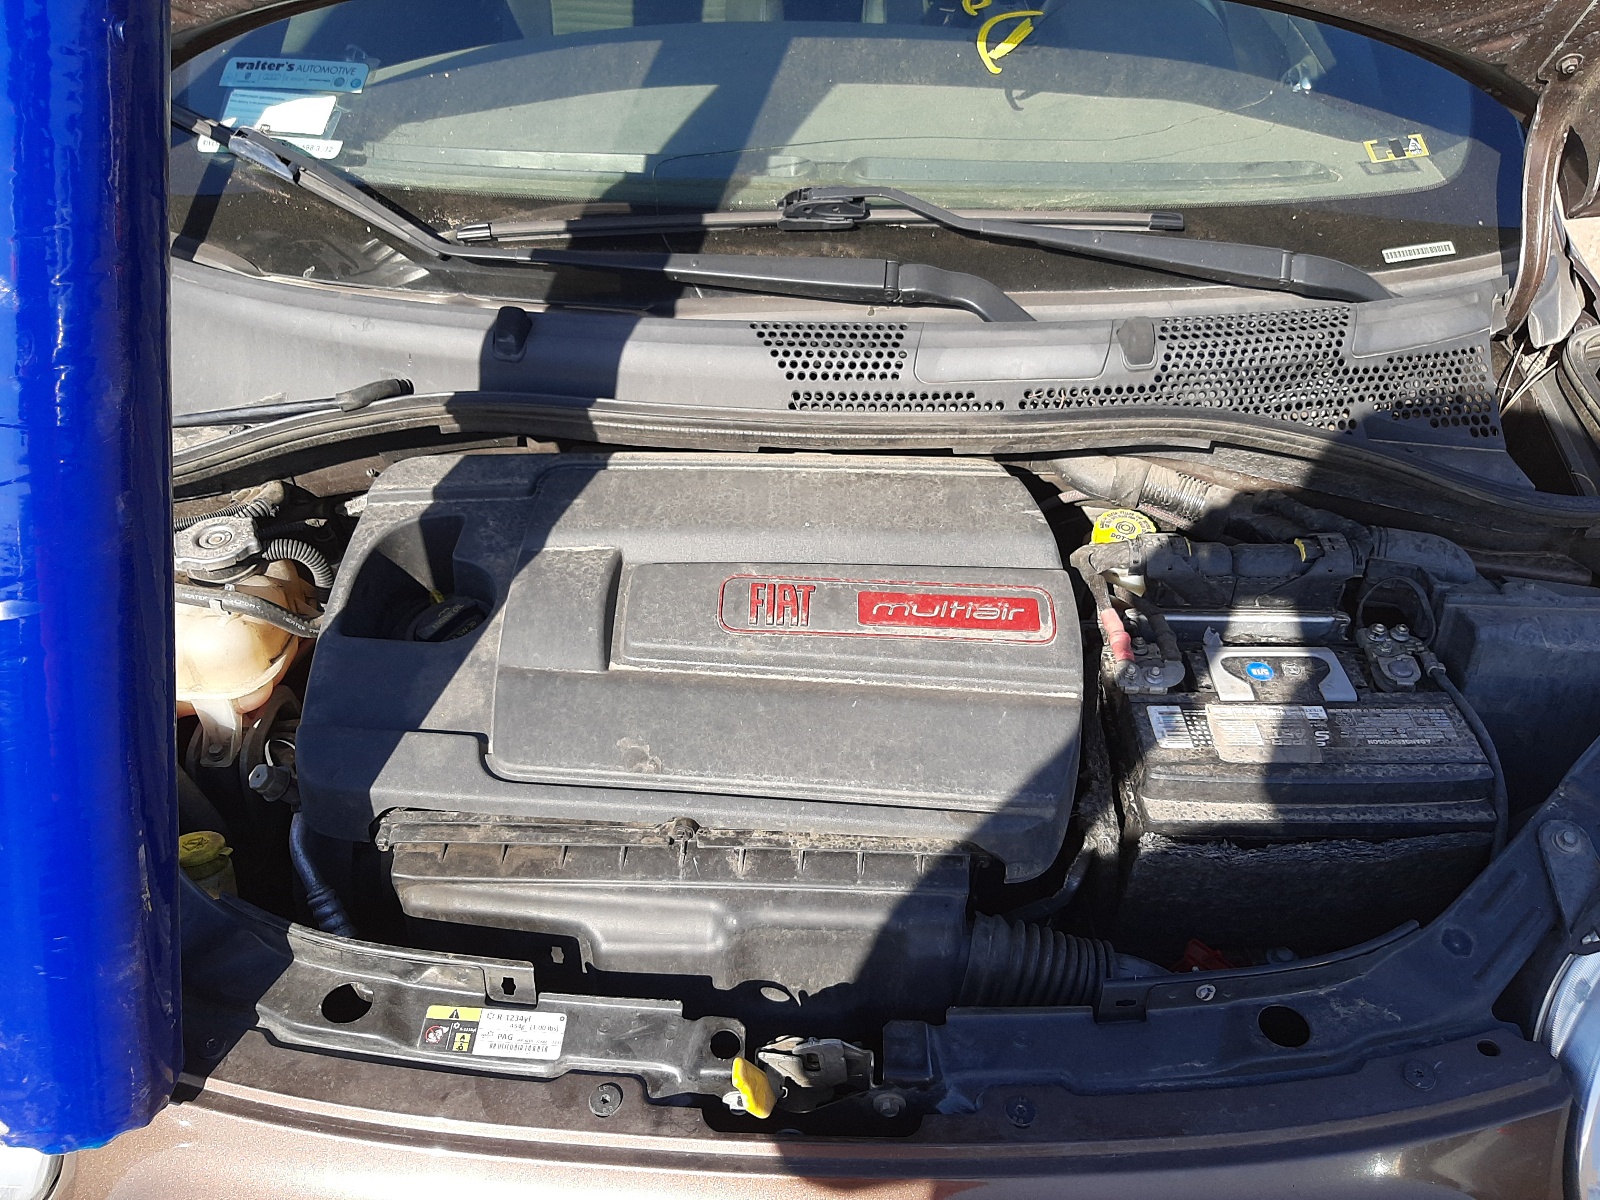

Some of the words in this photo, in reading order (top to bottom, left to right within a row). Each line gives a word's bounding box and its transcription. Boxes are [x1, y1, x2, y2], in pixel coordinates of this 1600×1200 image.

[236, 60, 295, 72] walter's
[296, 65, 357, 77] AUTOMOTIVE
[1110, 533, 1127, 541] DOT
[749, 583, 816, 627] FIAT
[872, 600, 1025, 621] multiair
[497, 1033, 513, 1041] PAG
